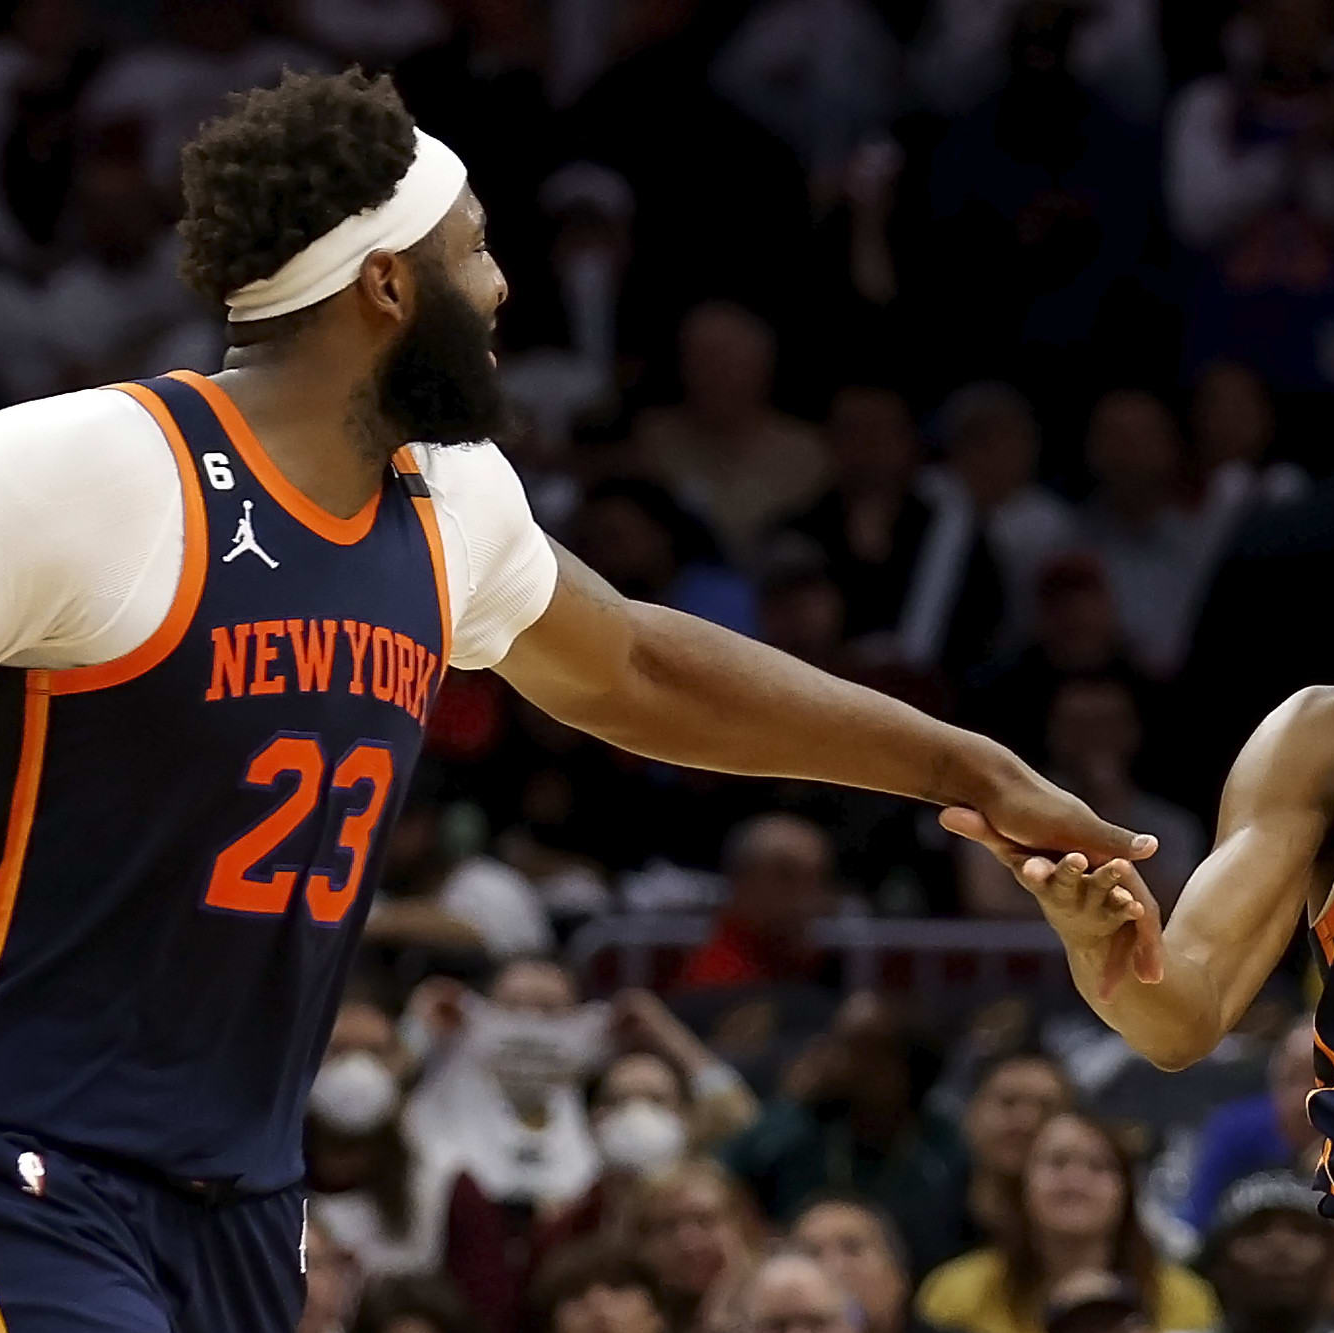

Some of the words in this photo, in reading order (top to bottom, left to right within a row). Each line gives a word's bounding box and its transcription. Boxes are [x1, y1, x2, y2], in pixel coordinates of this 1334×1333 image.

[201, 452, 235, 491] 6
[205, 618, 338, 702] NEW
[343, 618, 439, 727] YORK
[202, 734, 395, 927] 23
